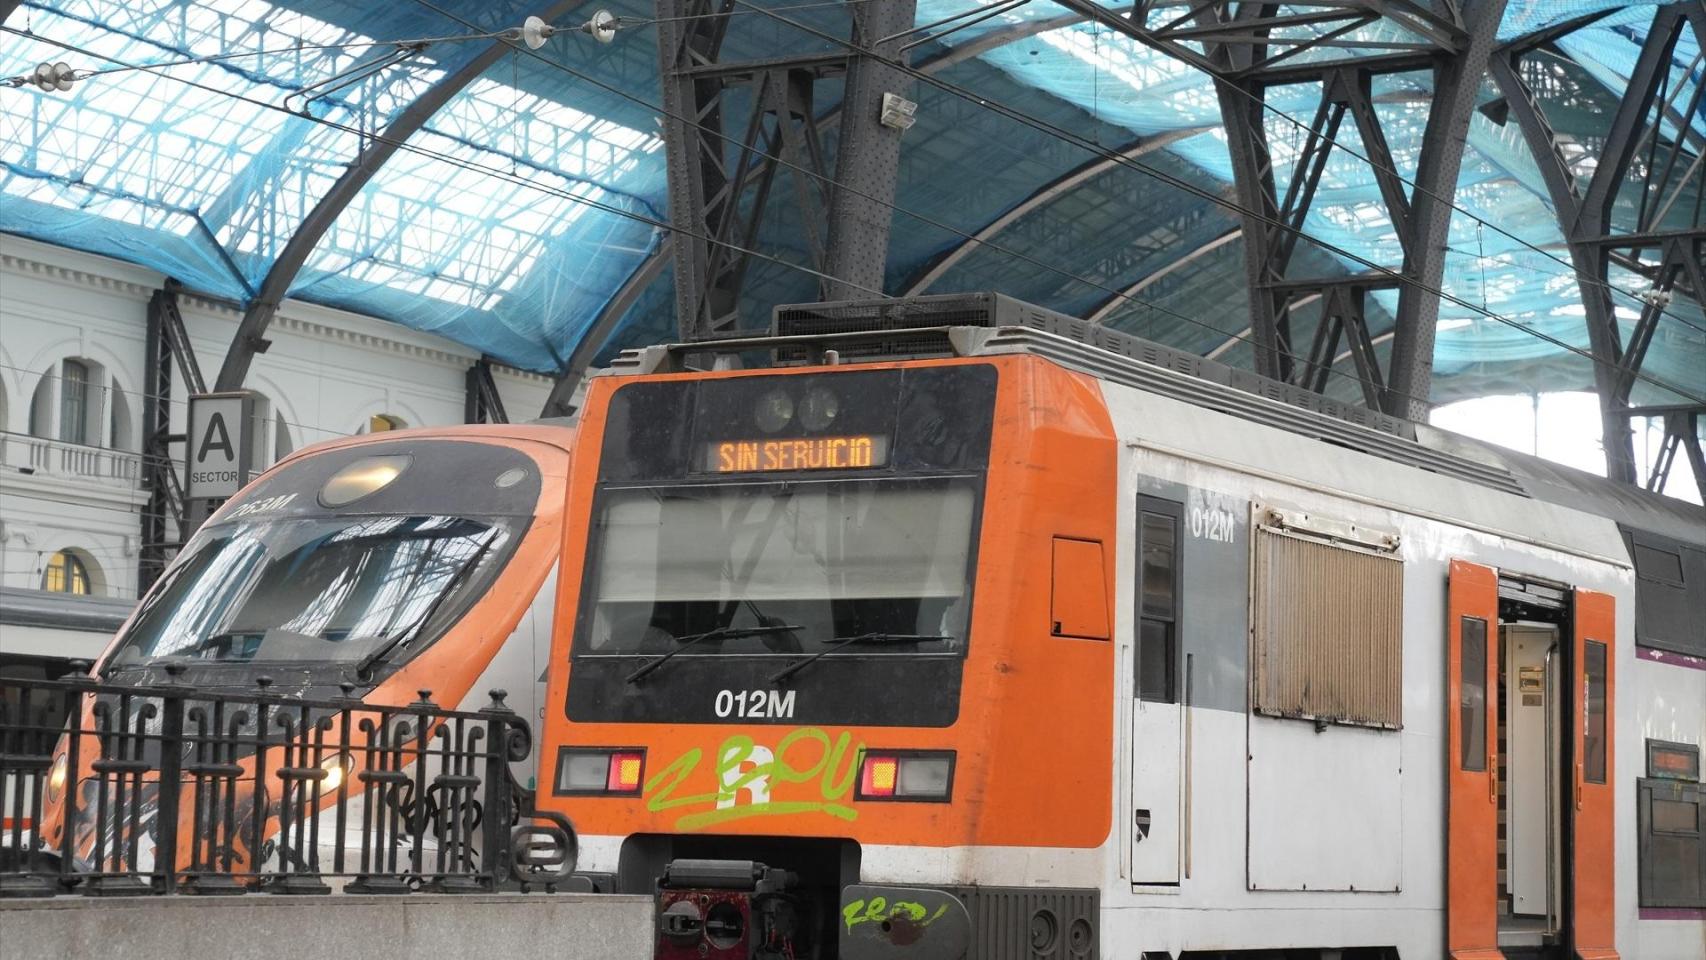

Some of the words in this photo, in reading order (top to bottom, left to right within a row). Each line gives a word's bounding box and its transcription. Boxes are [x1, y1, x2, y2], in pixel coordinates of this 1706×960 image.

[197, 411, 235, 463] A
[719, 442, 758, 472] SIN
[191, 471, 238, 483] SECTOR
[1192, 507, 1234, 544] 012M
[714, 689, 797, 718] 012M
